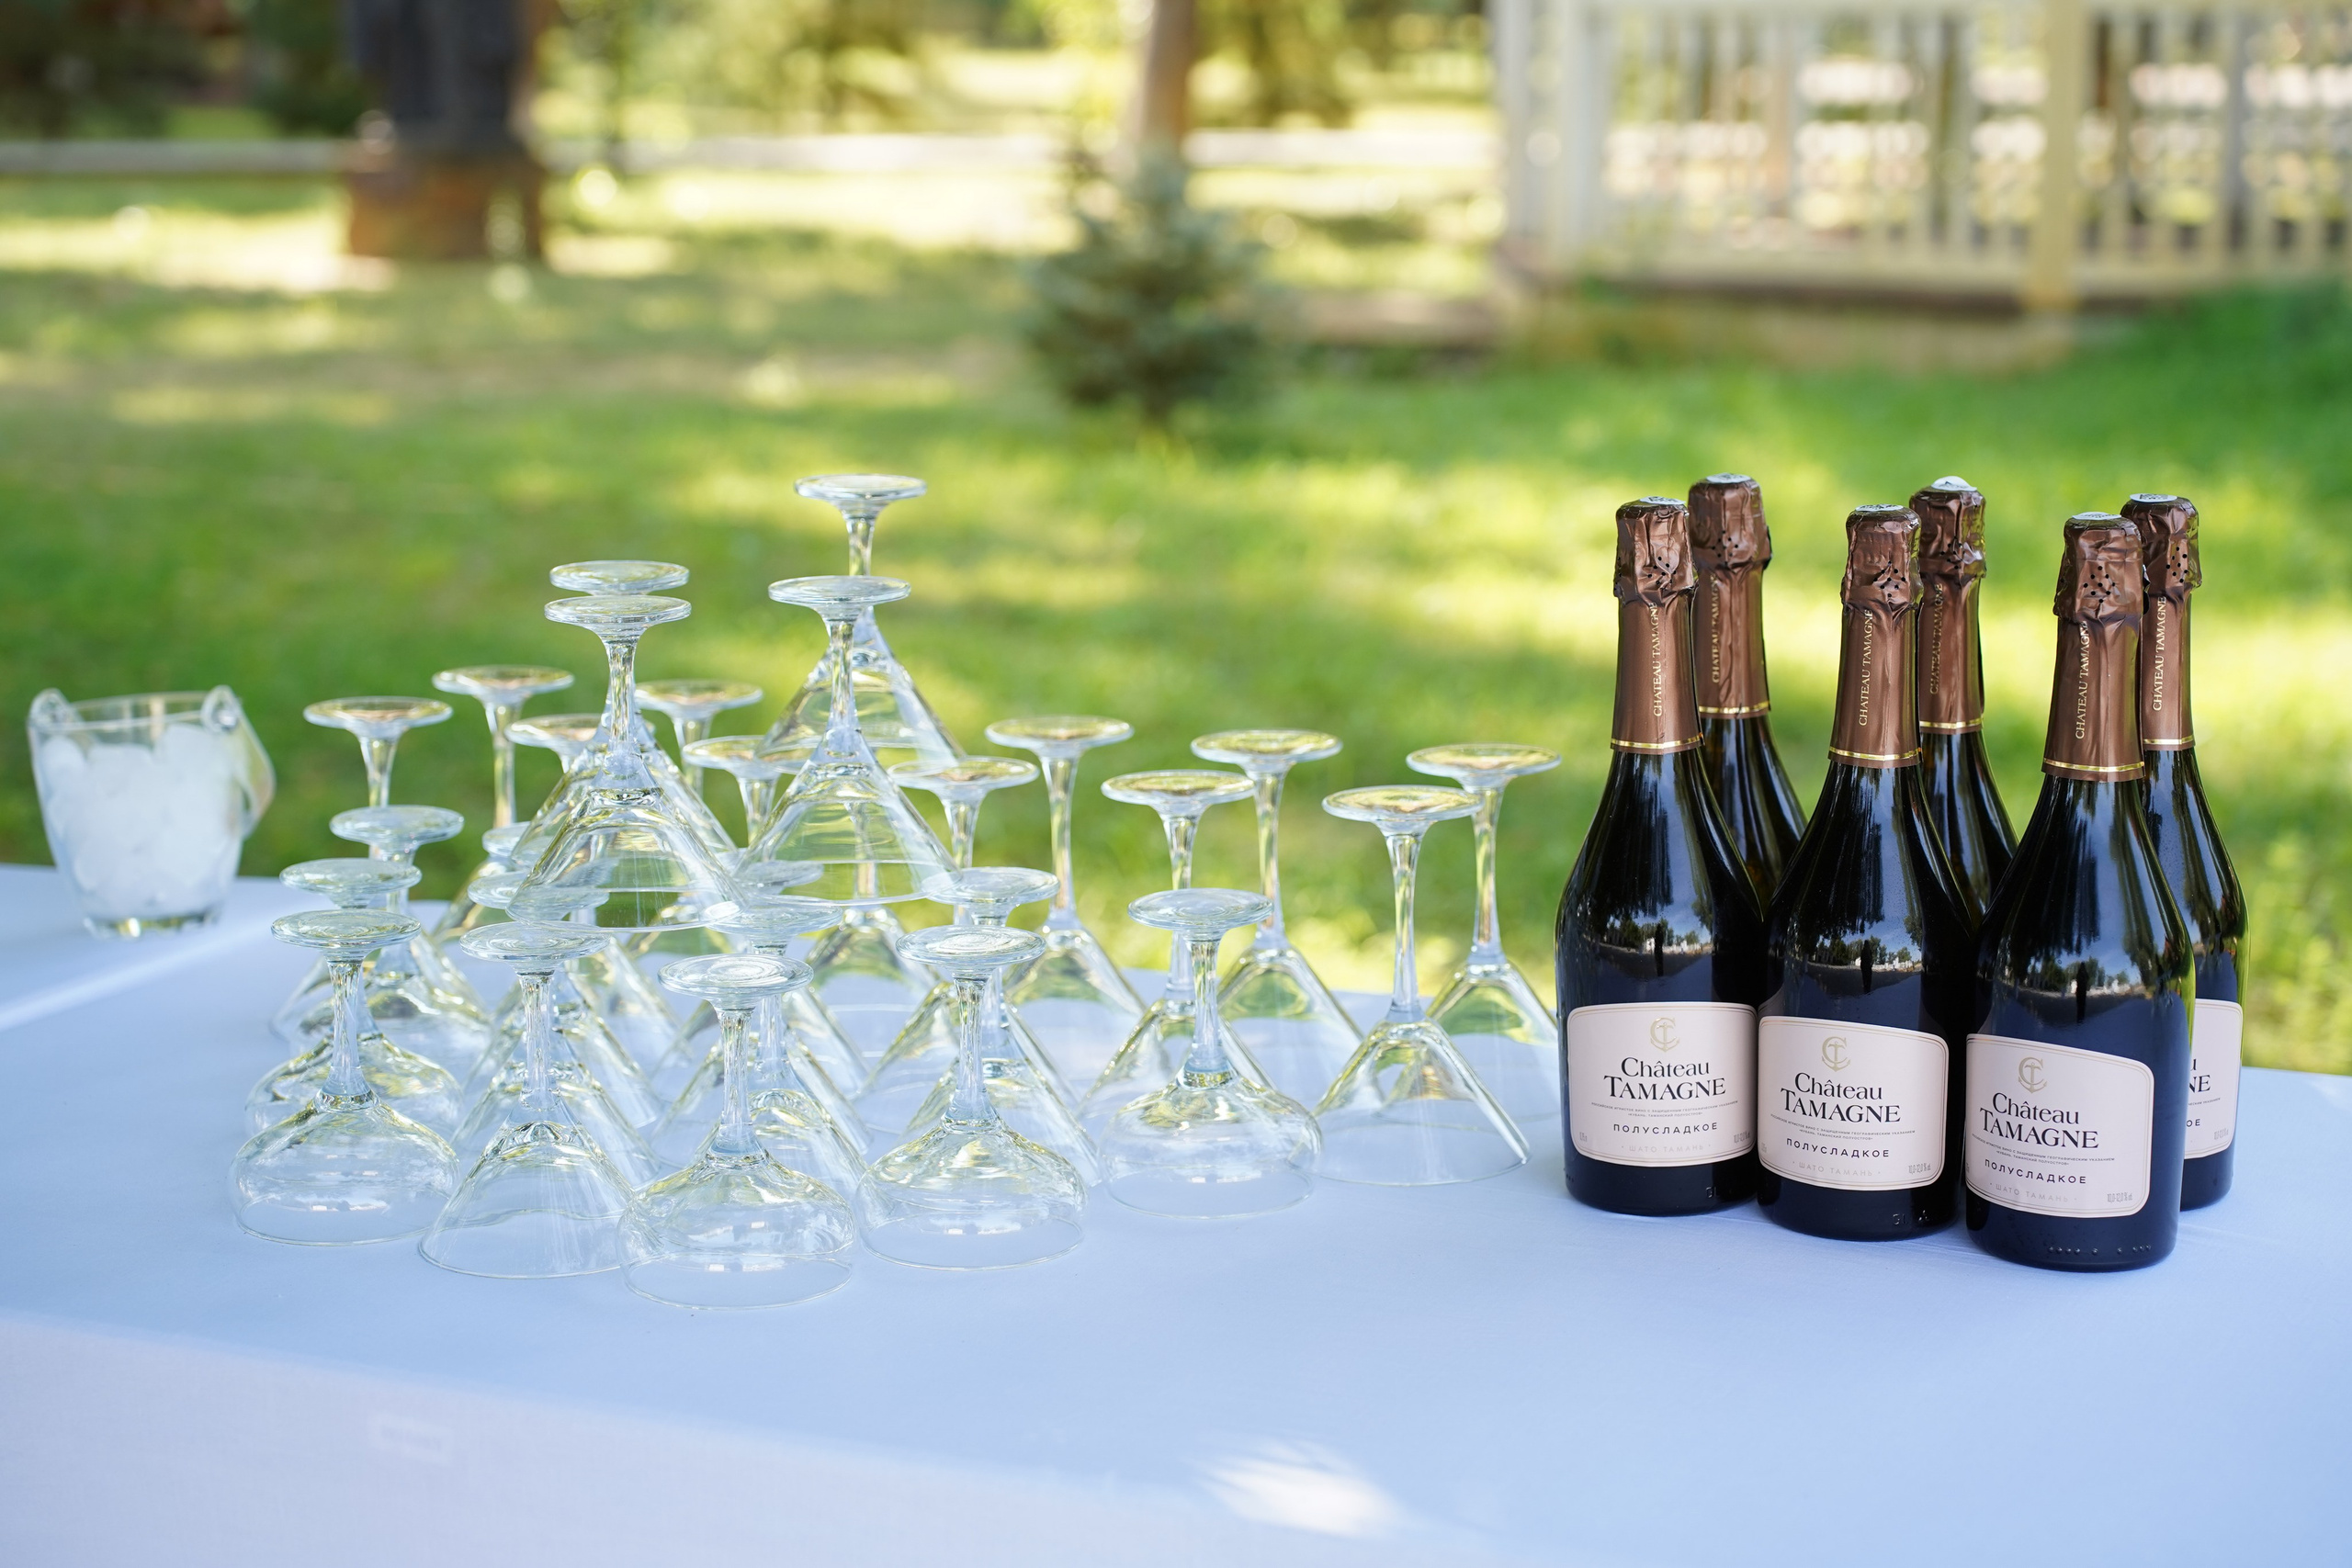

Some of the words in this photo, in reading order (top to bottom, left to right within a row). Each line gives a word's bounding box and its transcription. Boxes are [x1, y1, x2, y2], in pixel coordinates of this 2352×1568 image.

[1863, 609, 1873, 667] TAMAGNE
[2156, 596, 2166, 653] TAMAGNE
[1712, 629, 1720, 683] CHATEAU
[1930, 638, 1941, 695] CHATEAU
[1654, 660, 1664, 717] CHATEAU
[1859, 669, 1870, 727] CHATEAU
[2153, 655, 2164, 711] CHATEAU
[2075, 681, 2087, 739] CHATEAU
[1621, 1057, 1710, 1077] Château
[1604, 1076, 1726, 1100] TAMAGNE
[1795, 1073, 1883, 1100] Château
[1781, 1088, 1901, 1123] TAMAGNE
[1993, 1093, 2079, 1124] Château
[1613, 1122, 1718, 1134] ПОЛУСЛАДКОЕ
[1980, 1108, 2099, 1148] TAMAGNE
[1663, 1145, 1703, 1153] ТАМАНЬ
[1786, 1138, 1890, 1158] ПОЛУСЛАДКОЕ
[1799, 1162, 1825, 1173] ШАТО
[1830, 1166, 1873, 1177] ТАМАНЬ
[1984, 1159, 2086, 1184] ПОЛУСЛАДКОЕ
[1996, 1184, 2020, 1196] ШАТО
[2026, 1191, 2068, 1202] ТАМАНЬ
